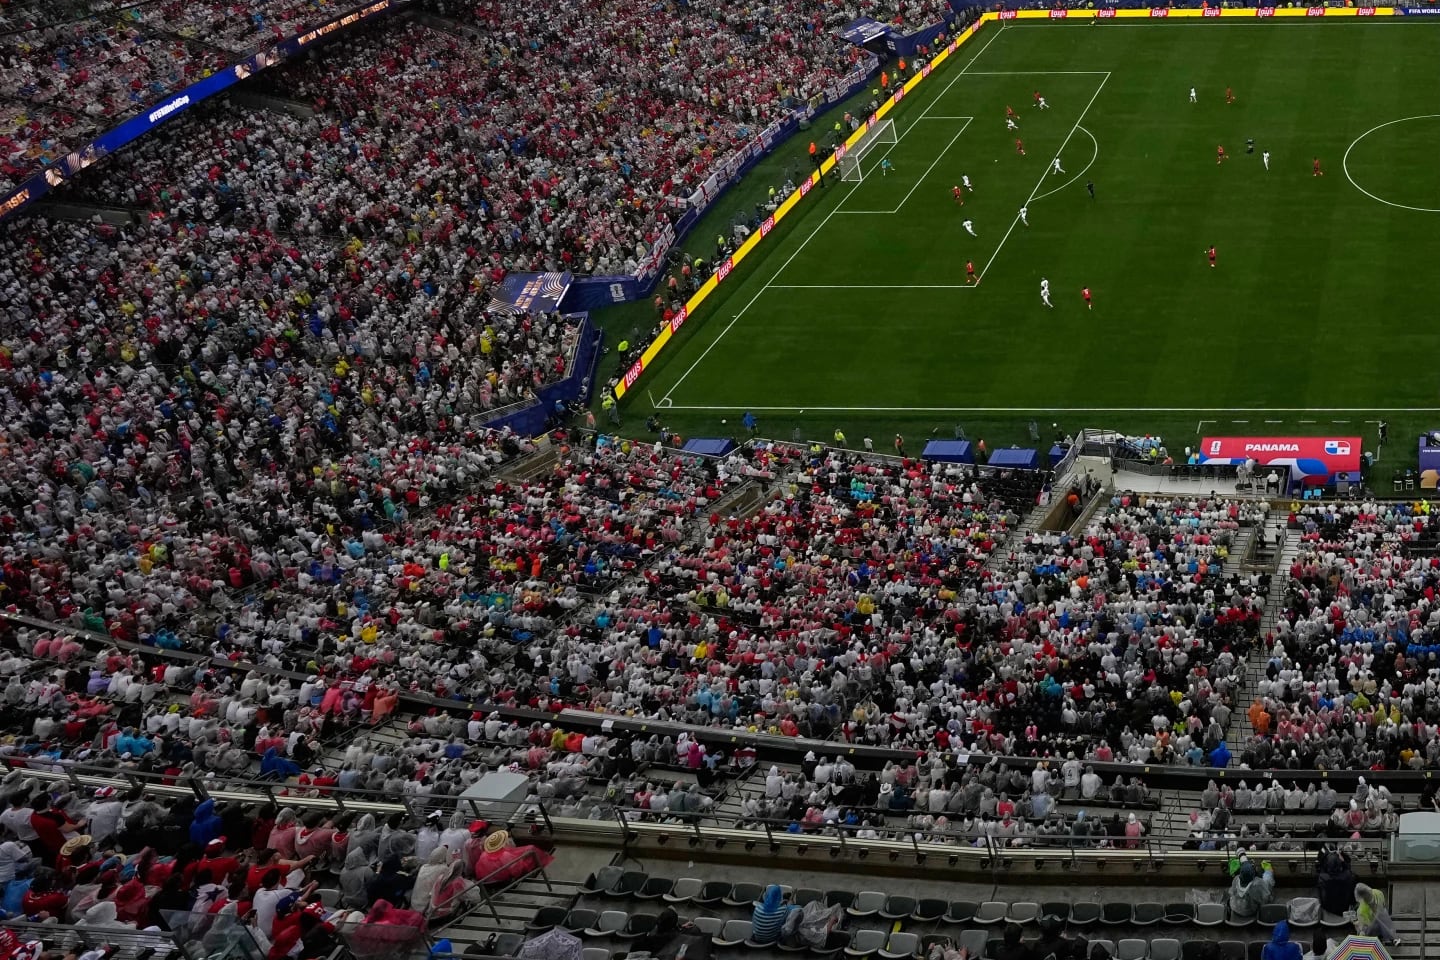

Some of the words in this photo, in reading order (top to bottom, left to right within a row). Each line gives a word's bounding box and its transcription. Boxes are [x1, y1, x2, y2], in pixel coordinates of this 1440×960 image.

[1000, 10, 1017, 19] Lay's
[1050, 10, 1067, 18] Lay's
[1099, 10, 1116, 18] Lay's
[1151, 9, 1169, 18] Lay's
[1203, 8, 1221, 17] Lay's
[1257, 8, 1275, 17] Lay's
[1307, 7, 1325, 16] Lay's
[1357, 7, 1375, 16] Lay's
[340, 11, 360, 26] NEW
[760, 215, 775, 237] Lay's
[718, 258, 734, 282] Lay's
[671, 306, 688, 333] Lay's
[625, 359, 642, 386] Lay's
[1245, 443, 1300, 452] PANAMA
